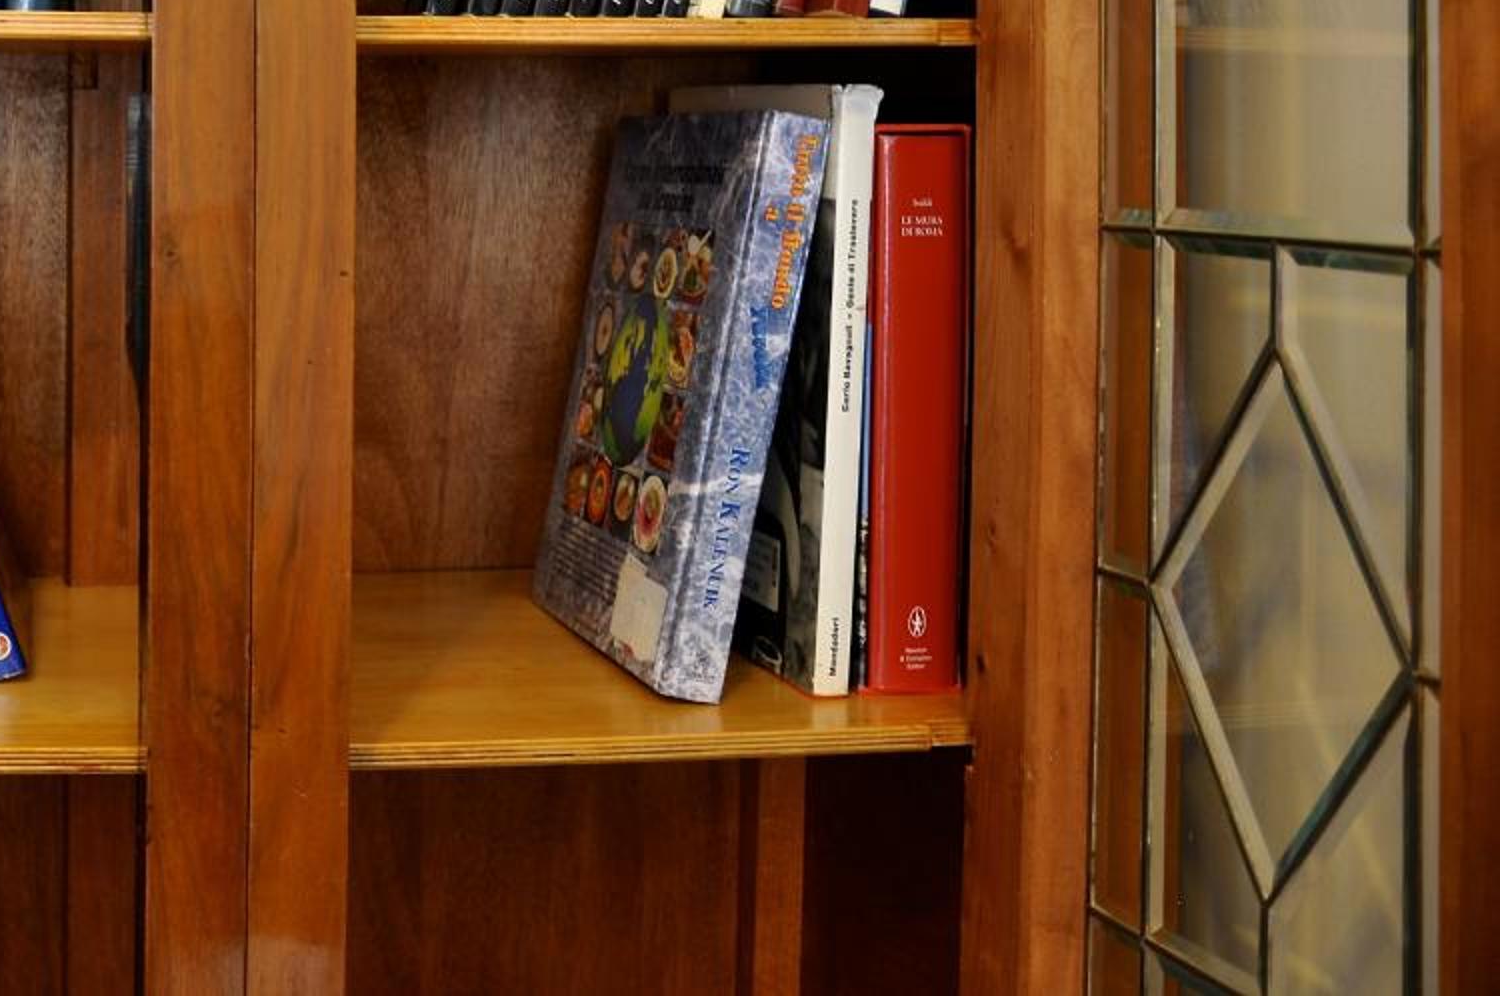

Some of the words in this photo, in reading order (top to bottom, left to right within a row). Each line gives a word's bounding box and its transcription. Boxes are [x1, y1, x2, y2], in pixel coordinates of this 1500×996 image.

[847, 198, 859, 259] Trastevere
[901, 215, 912, 225] LE
[901, 227, 912, 237] DI
[914, 227, 943, 237] ROMA
[847, 262, 855, 273] di
[845, 276, 855, 308] Gente
[841, 381, 850, 411] Carlo
[724, 447, 750, 495] RON
[827, 617, 839, 676] Mondadori
